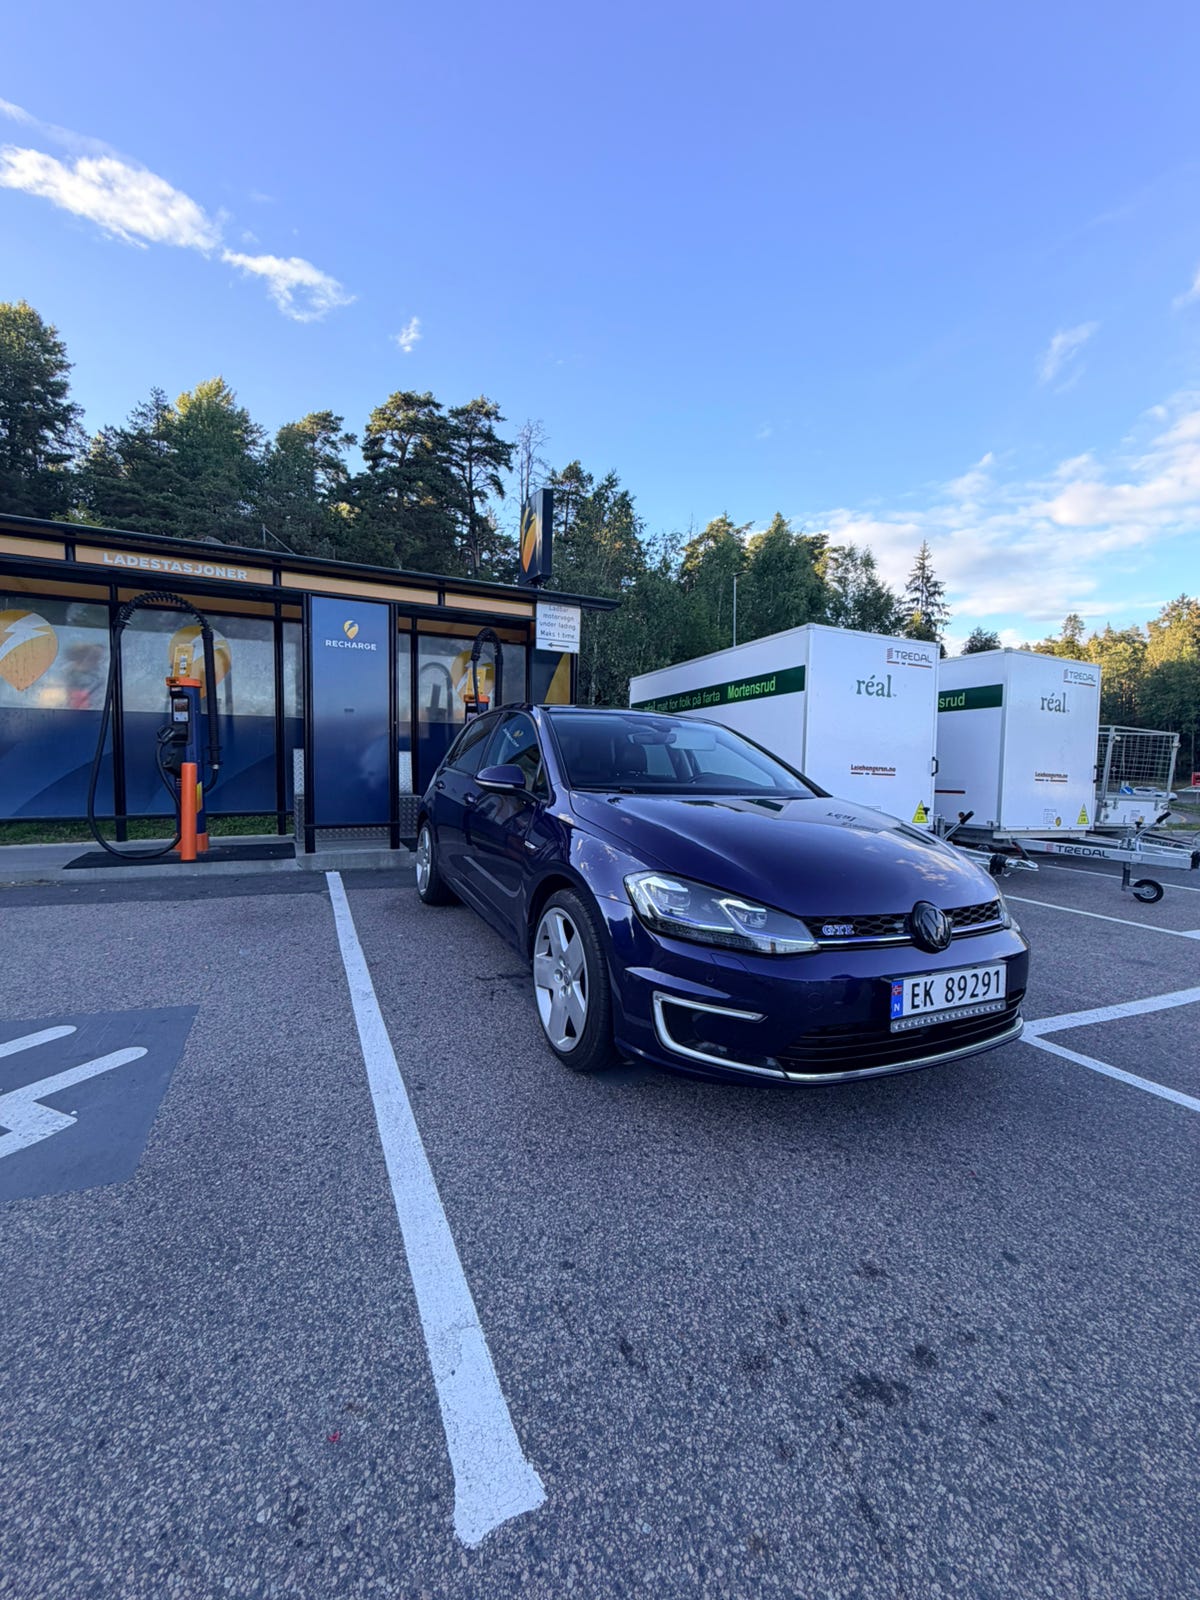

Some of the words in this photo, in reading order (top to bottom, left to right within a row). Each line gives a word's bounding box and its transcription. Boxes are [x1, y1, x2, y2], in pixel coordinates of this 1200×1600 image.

[103, 552, 248, 580] LADESTASJONER
[558, 623, 576, 631] lading
[325, 639, 377, 651] RECHARGE
[895, 650, 933, 663] TREDAL
[1069, 671, 1096, 683] TREDAL
[669, 699, 678, 710] for
[680, 696, 691, 707] folk
[692, 693, 702, 708] på
[703, 691, 720, 703] farta
[727, 676, 776, 699] Mortensrud
[856, 674, 892, 698] réal
[1040, 692, 1066, 713] réal
[1055, 844, 1111, 858] TREDAL
[822, 924, 855, 936] GTE
[894, 1002, 900, 1012] N
[911, 980, 934, 1010] EK
[944, 969, 1000, 1003] 89291
